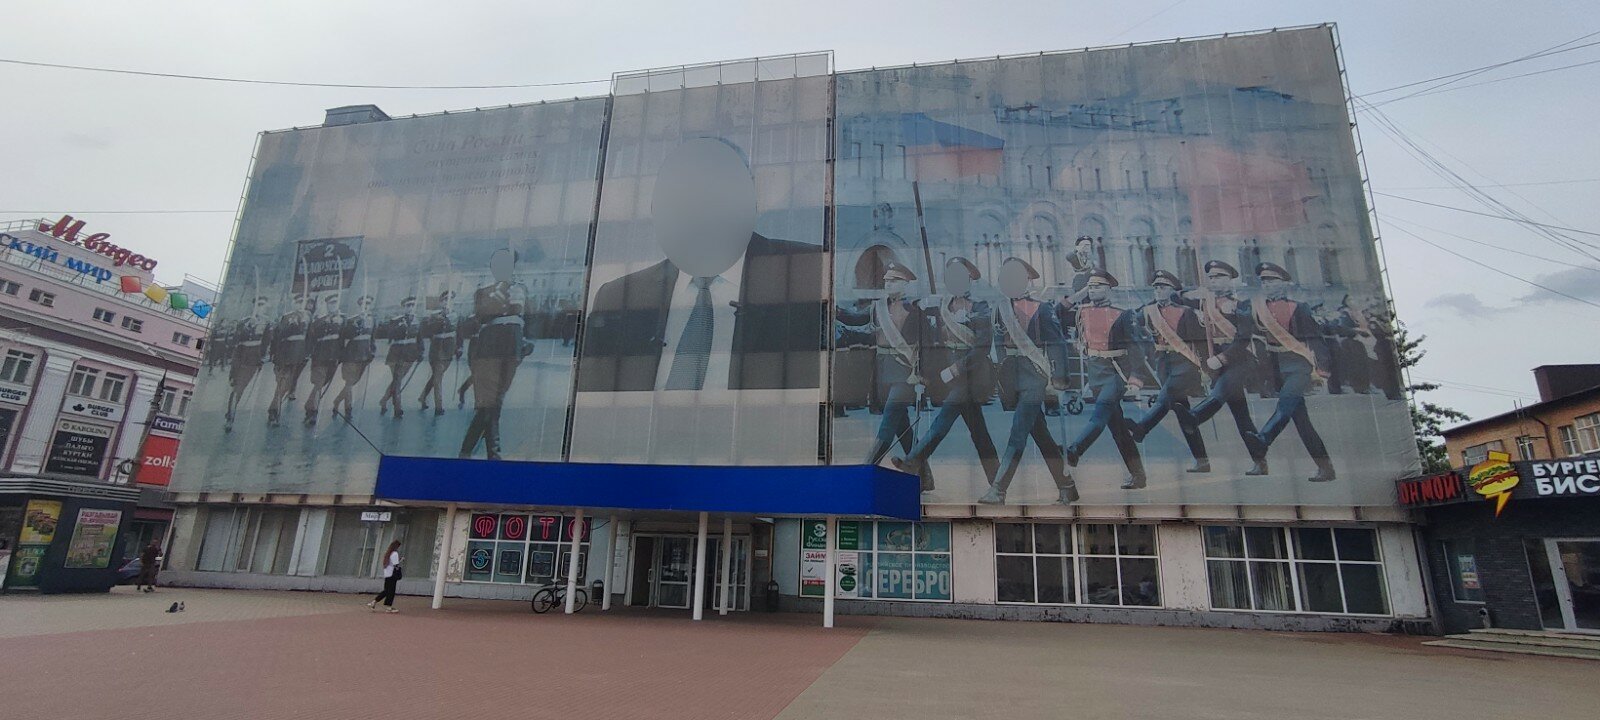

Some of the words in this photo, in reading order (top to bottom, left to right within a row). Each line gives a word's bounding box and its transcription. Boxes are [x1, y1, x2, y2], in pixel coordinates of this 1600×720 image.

[413, 140, 455, 154] Сила
[324, 244, 335, 258] 2
[65, 257, 112, 284] мир
[299, 255, 356, 274] БЛОРУССКИЙ
[1, 393, 20, 401] CLUB
[87, 403, 114, 413] BURGER
[71, 424, 107, 436] KAROLINA
[65, 442, 94, 451] ПАЛЬТО
[71, 435, 94, 444] ШУБЫ
[63, 450, 93, 458] КУРТКИ
[1532, 459, 1600, 477] БУРГЕ
[474, 516, 586, 538] ФОТО
[865, 569, 950, 595] СЕРЕБРО
